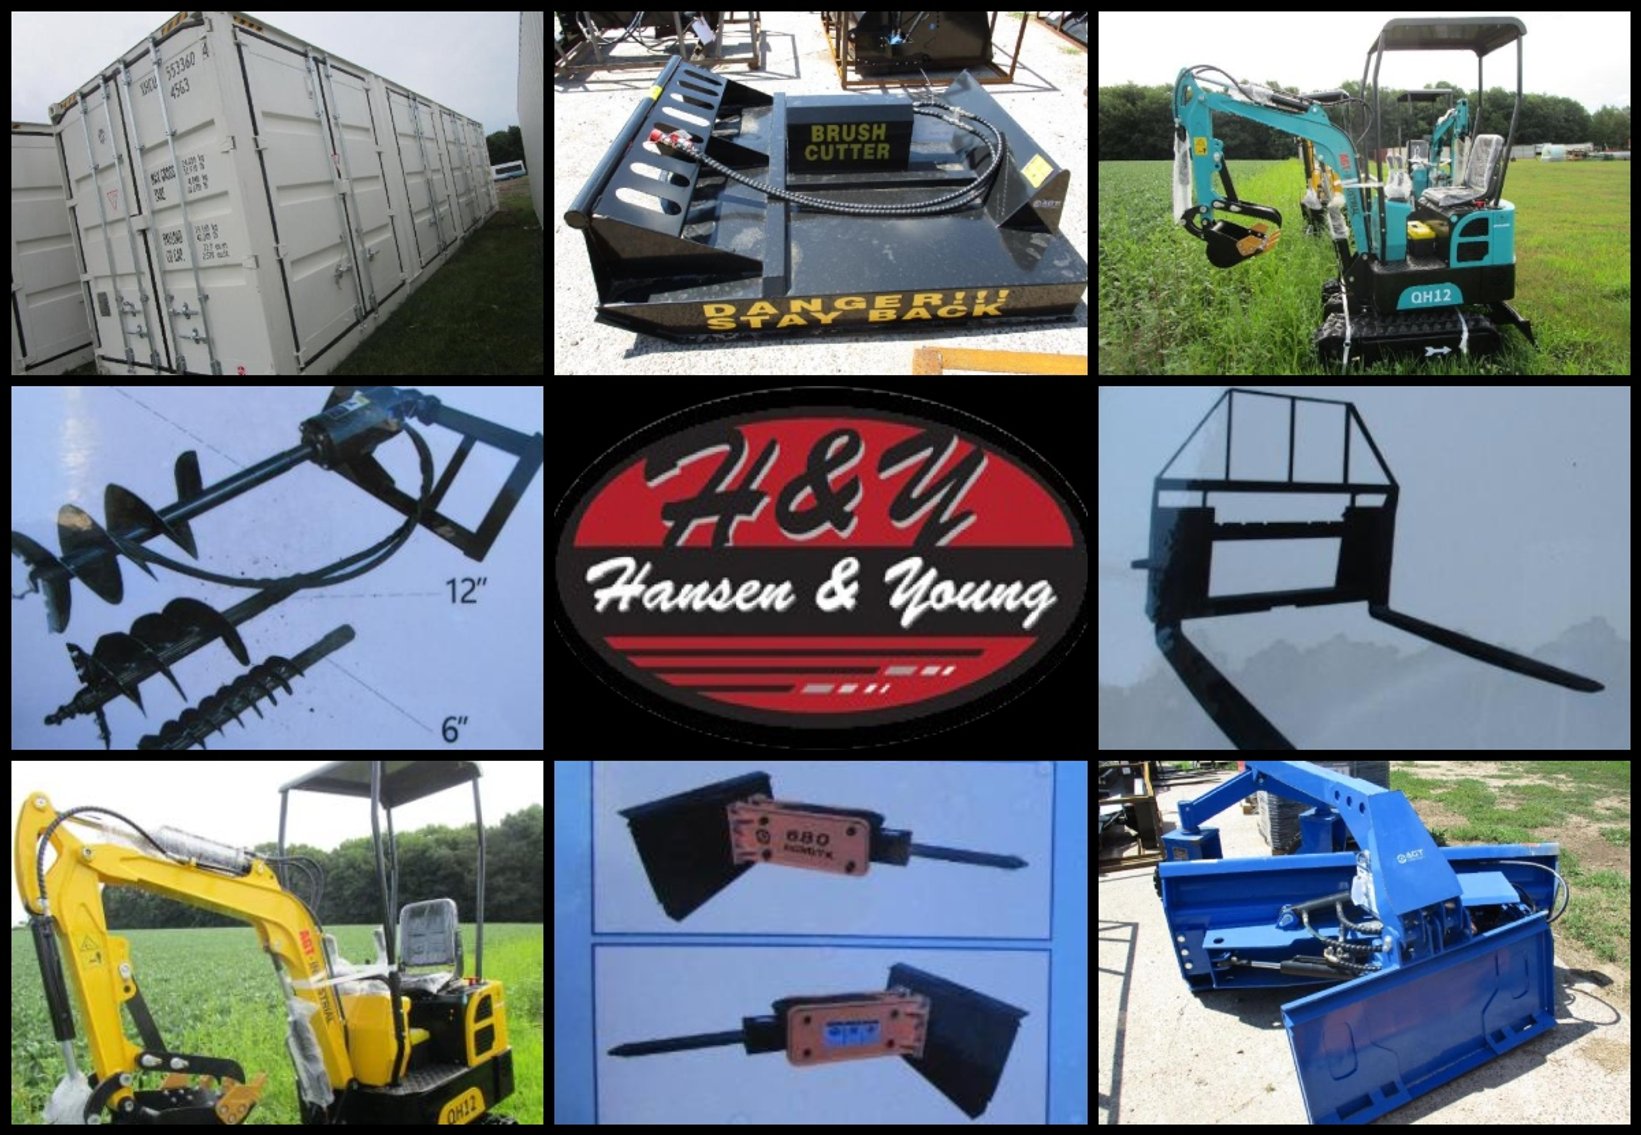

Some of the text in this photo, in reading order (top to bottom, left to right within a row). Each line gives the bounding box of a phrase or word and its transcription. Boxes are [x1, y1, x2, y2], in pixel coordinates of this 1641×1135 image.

[811, 123, 886, 142] BRUSH
[804, 143, 890, 161] CUTTER
[702, 289, 1009, 318] DANGER!!!
[1411, 288, 1452, 304] QH12
[706, 303, 1003, 330] STAY BACK
